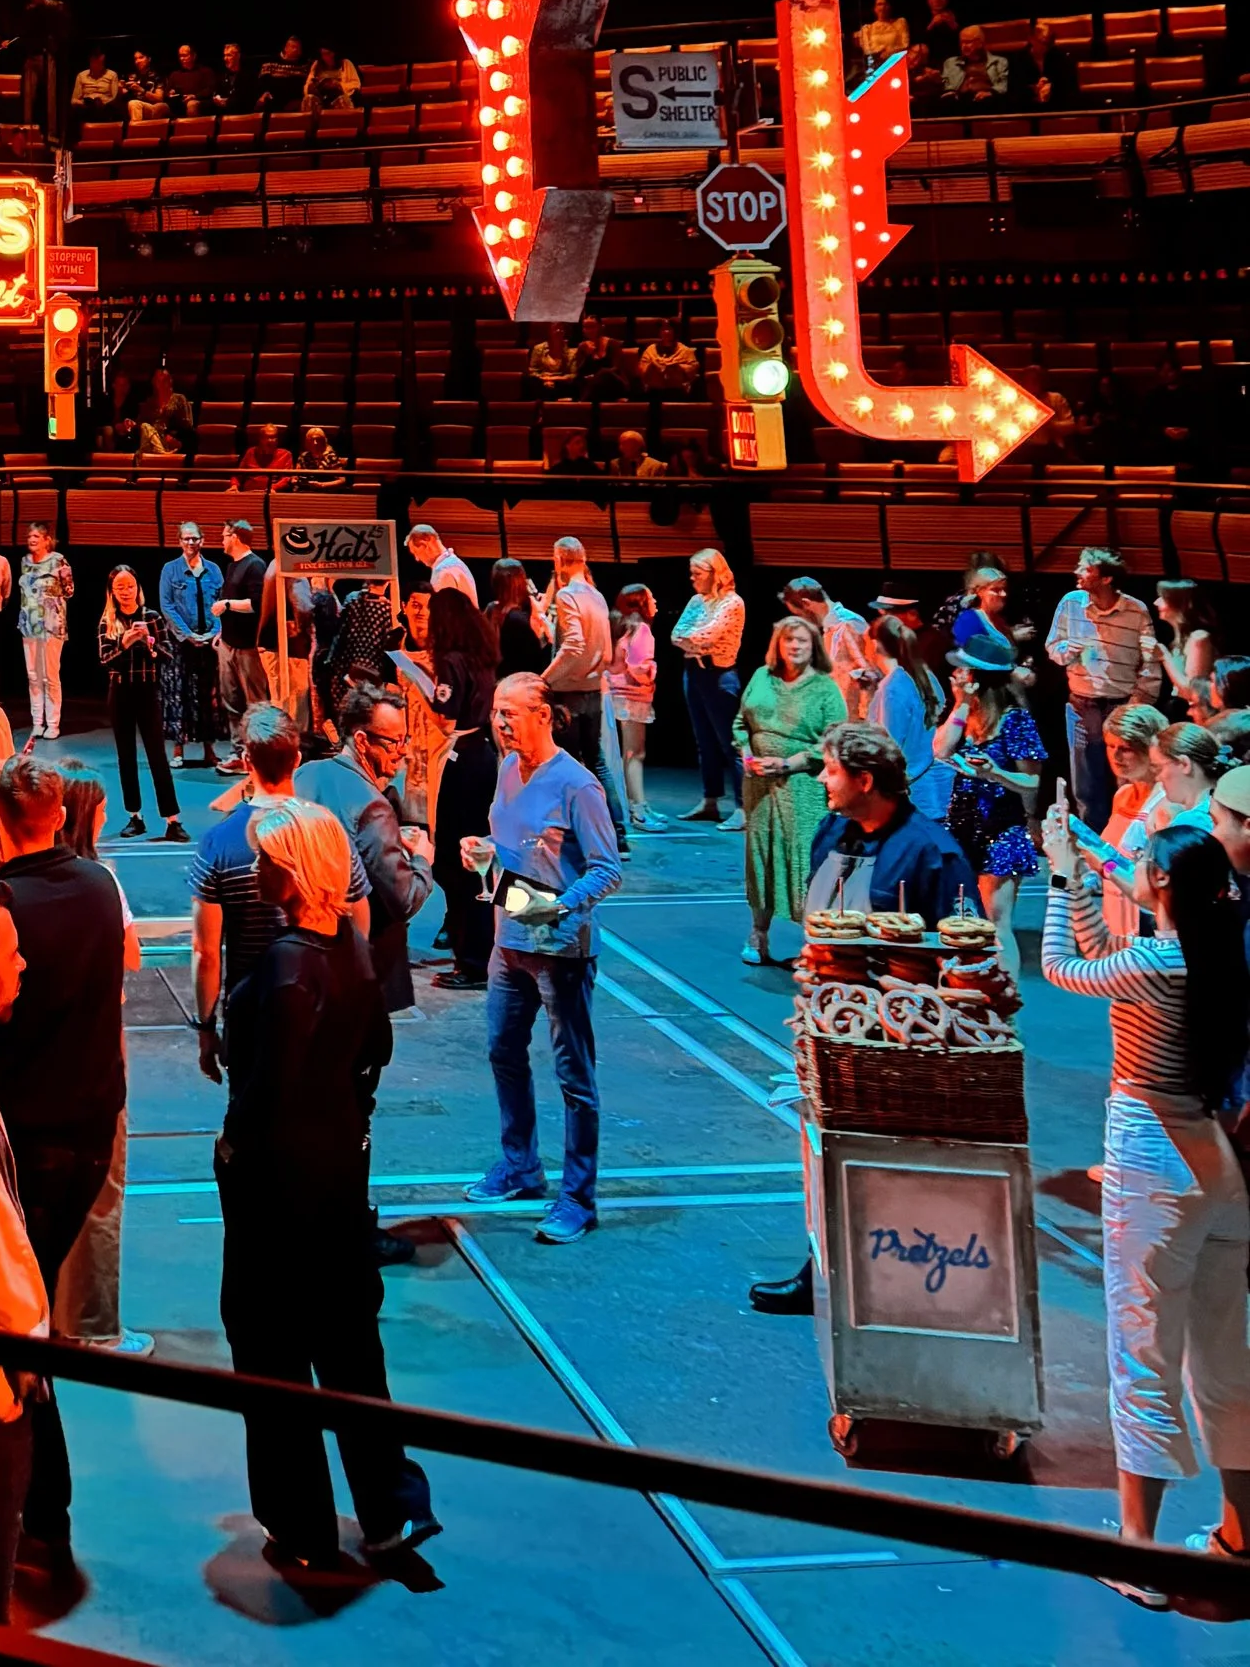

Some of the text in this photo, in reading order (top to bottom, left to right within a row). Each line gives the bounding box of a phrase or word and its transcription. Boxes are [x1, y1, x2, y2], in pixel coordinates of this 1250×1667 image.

[658, 65, 708, 82] PUBLIC
[618, 64, 658, 120] S
[659, 105, 718, 122] SHELTER
[706, 190, 778, 224] STOP
[48, 264, 85, 275] NYTIME
[49, 252, 92, 262] STOPPING
[311, 526, 382, 563] Hats
[869, 1227, 991, 1293] Pretzels
